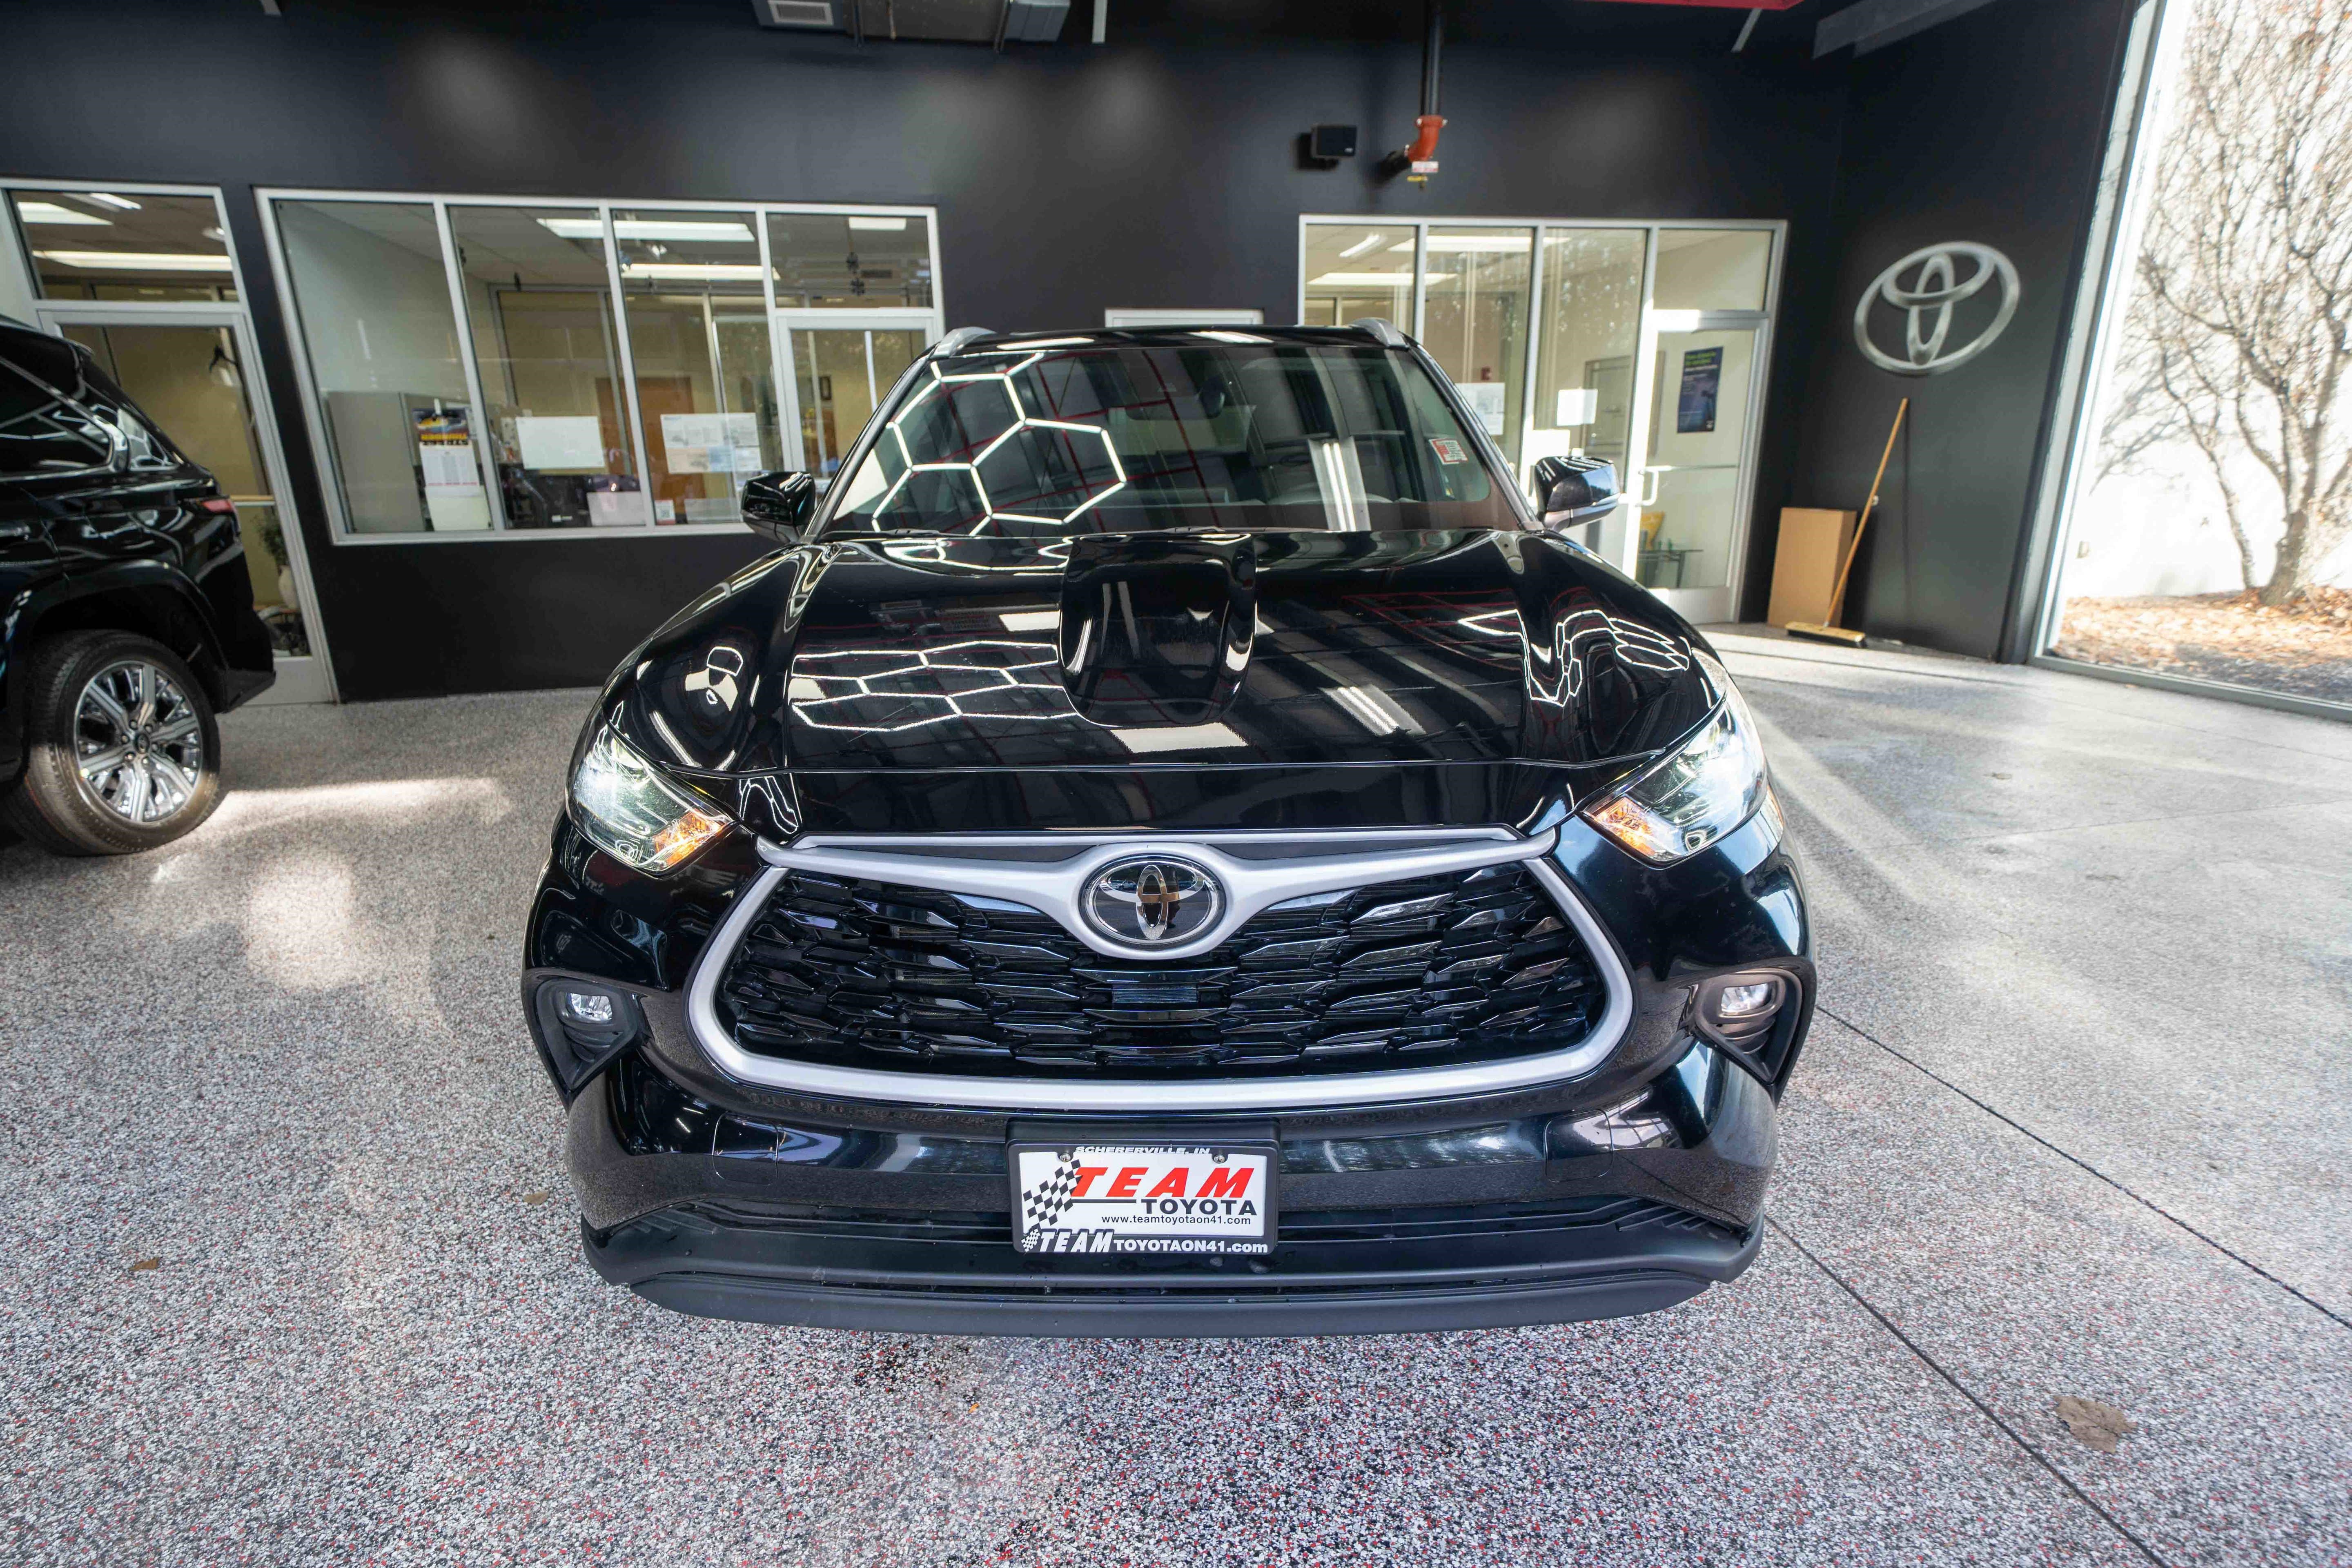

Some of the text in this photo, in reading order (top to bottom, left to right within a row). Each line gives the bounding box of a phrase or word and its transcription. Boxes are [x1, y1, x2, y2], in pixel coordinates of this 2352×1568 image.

[1071, 1167, 1254, 1198] TEAM
[1141, 1199, 1257, 1216] TOYOTA
[1101, 1215, 1251, 1225] www.teamtoyotaon41.com
[1040, 1232, 1268, 1253] TEAM TOYOTAON41.com
